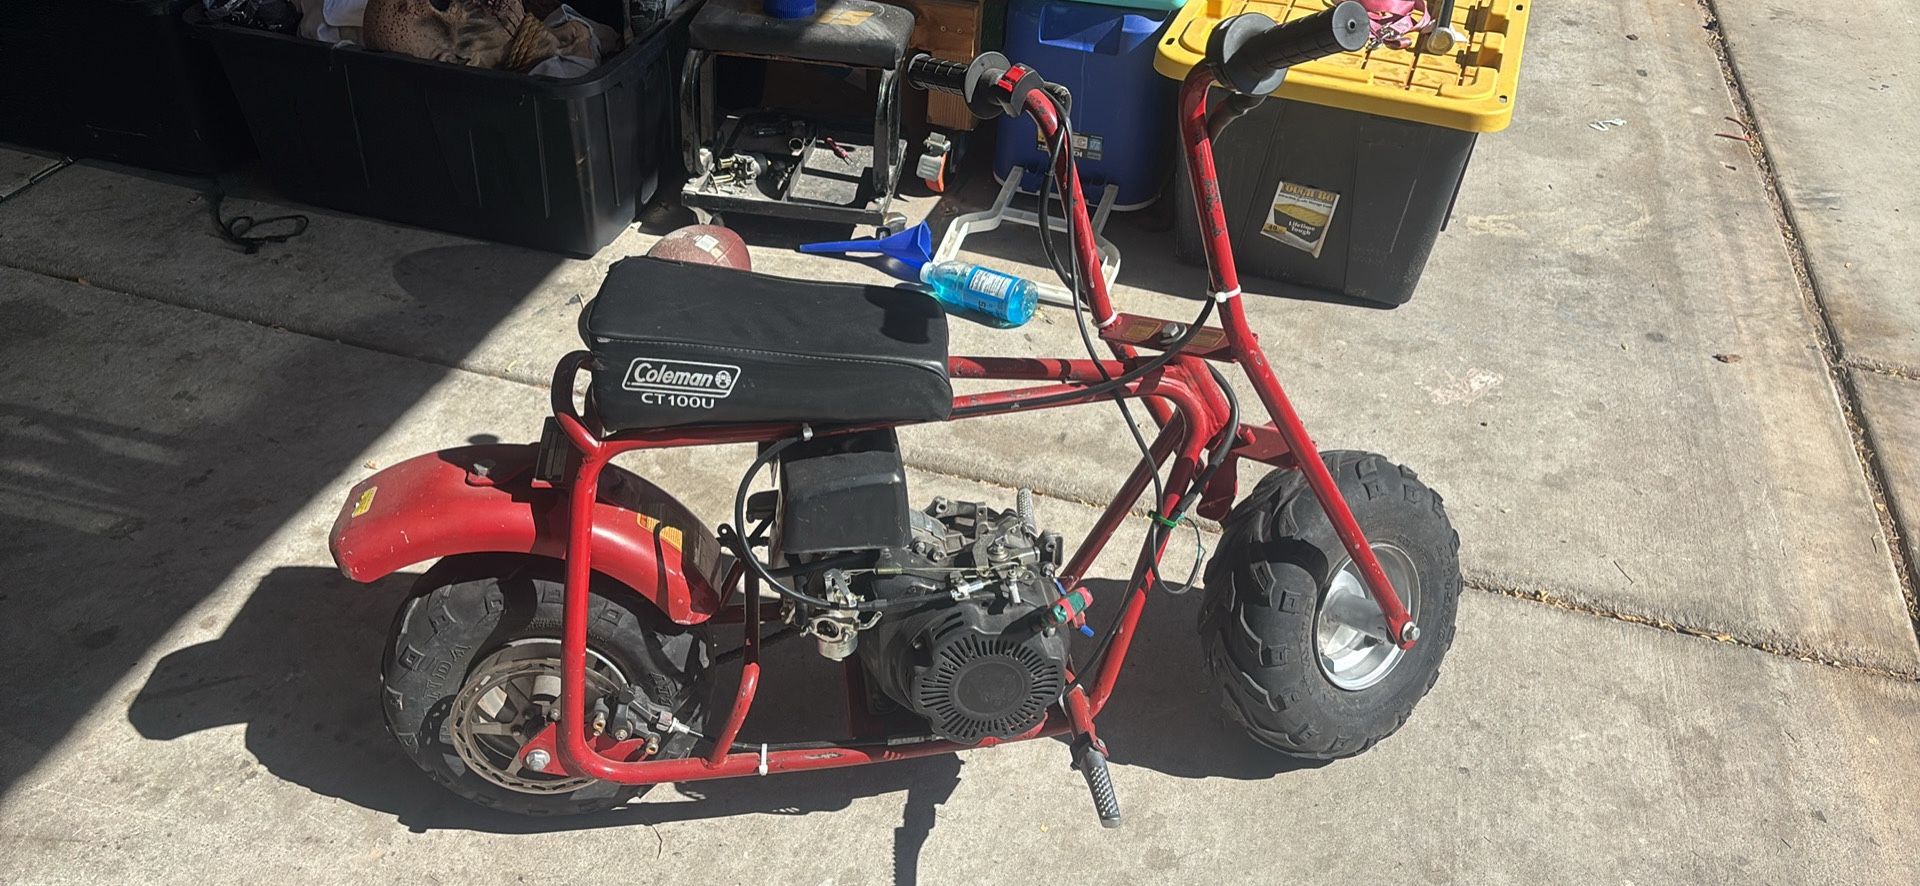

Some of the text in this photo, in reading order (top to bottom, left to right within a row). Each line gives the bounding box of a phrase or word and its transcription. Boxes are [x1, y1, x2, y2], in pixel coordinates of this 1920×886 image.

[1288, 220, 1316, 231] Lifetime
[1291, 226, 1312, 236] Tough
[634, 362, 714, 387] Coleman
[641, 392, 715, 409] CT100U
